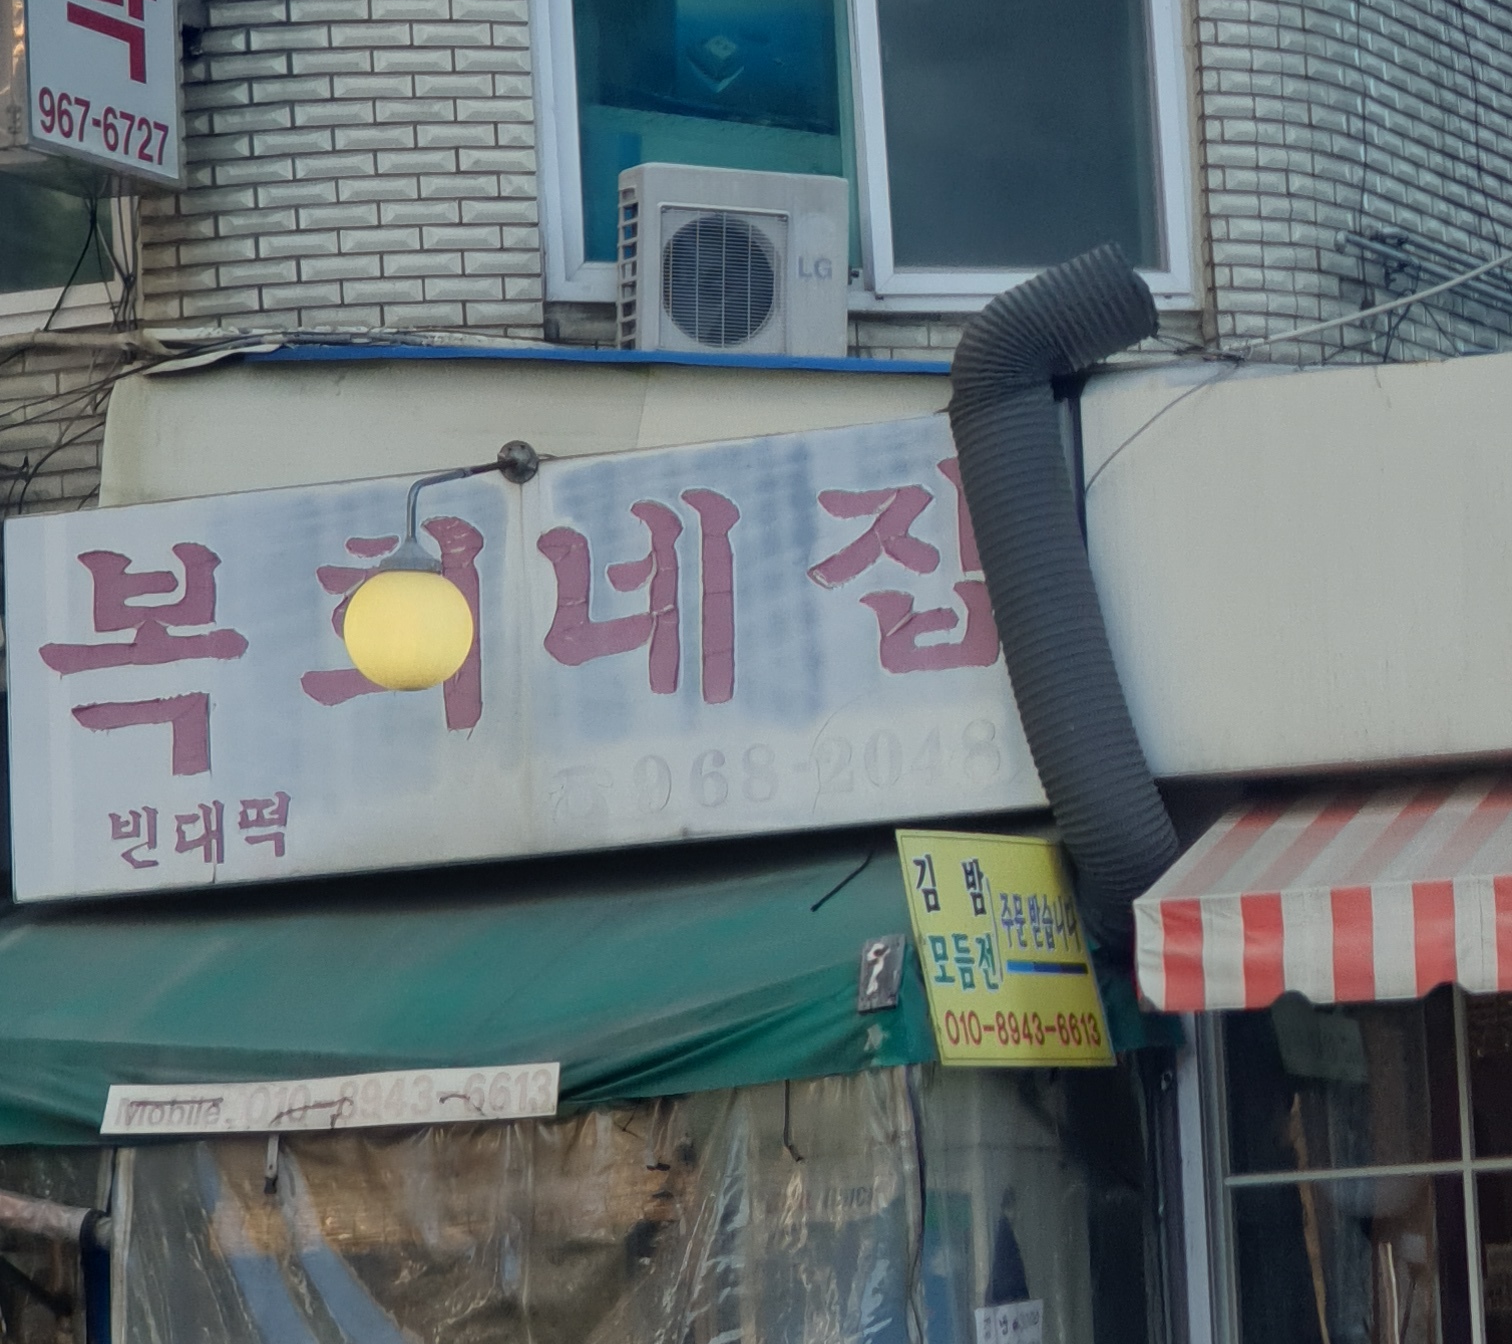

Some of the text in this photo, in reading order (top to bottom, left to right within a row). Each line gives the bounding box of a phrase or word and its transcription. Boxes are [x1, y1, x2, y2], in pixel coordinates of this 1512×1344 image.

[38, 86, 169, 166] 967-6727
[798, 256, 833, 281] LG
[107, 790, 293, 869] 빈대떡
[927, 933, 1000, 991] 모듬전
